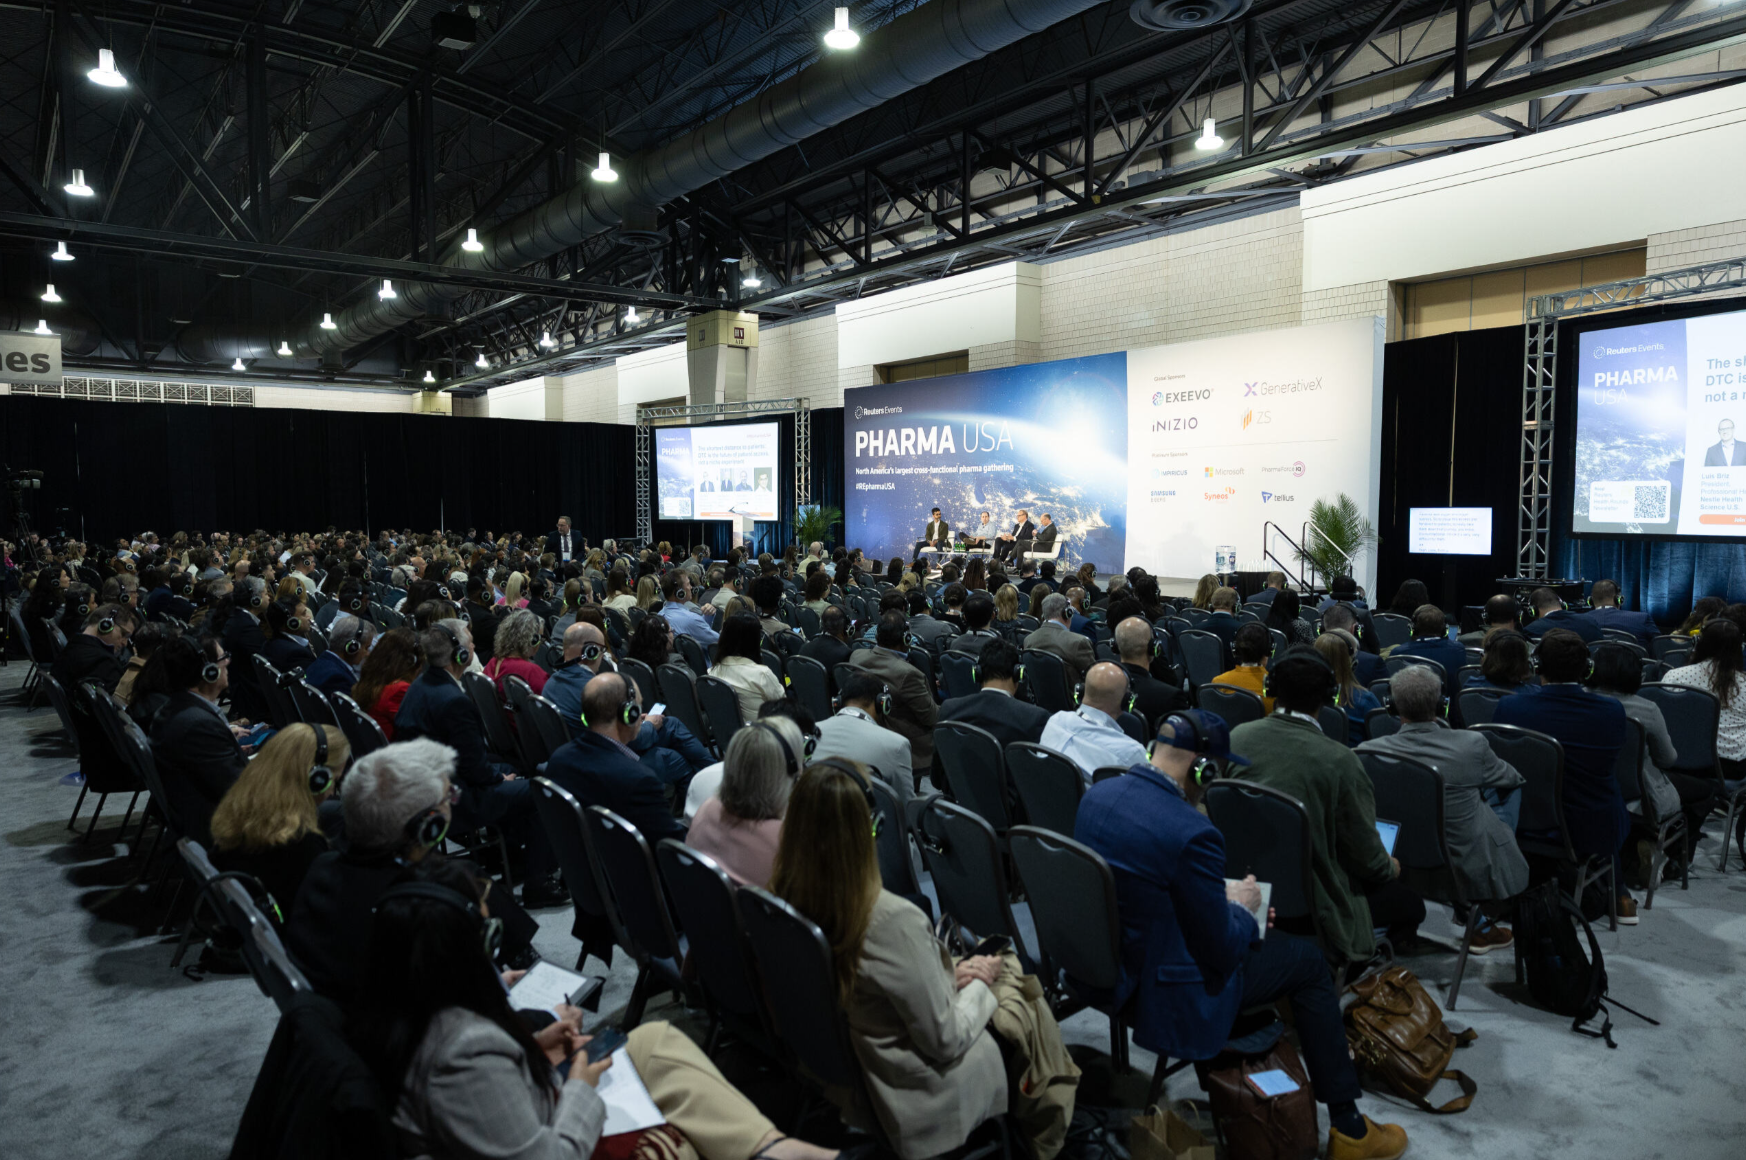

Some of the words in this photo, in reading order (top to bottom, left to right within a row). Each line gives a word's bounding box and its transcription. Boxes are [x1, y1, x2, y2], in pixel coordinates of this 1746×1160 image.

[1606, 345, 1637, 355] Reuters
[1638, 343, 1665, 352] Events
[0, 351, 51, 374] es
[1706, 358, 1731, 370] The
[1594, 365, 1679, 388] PHARMA
[1706, 373, 1734, 386] DTC
[1260, 376, 1323, 396] GenerativeX
[1165, 388, 1211, 403] EXEEVO
[1594, 388, 1629, 406] USA
[1705, 391, 1727, 402] not
[1730, 391, 1738, 401] a
[863, 407, 885, 416] Reuters
[885, 405, 903, 415] Events
[1256, 410, 1272, 425] ZS
[855, 425, 956, 458] PHARMA
[962, 420, 1014, 453] USA
[661, 447, 690, 456] PHARMA
[855, 467, 870, 475] North
[870, 466, 894, 475] America's
[895, 465, 913, 476] largest
[914, 464, 958, 474] cross-functional
[959, 464, 982, 474] pharma
[983, 462, 1014, 474] gathering
[1215, 467, 1245, 476] Microsoft
[855, 482, 896, 491] #REpharmaUSA
[1204, 492, 1229, 502] Syneos
[1274, 494, 1295, 502] tellius
